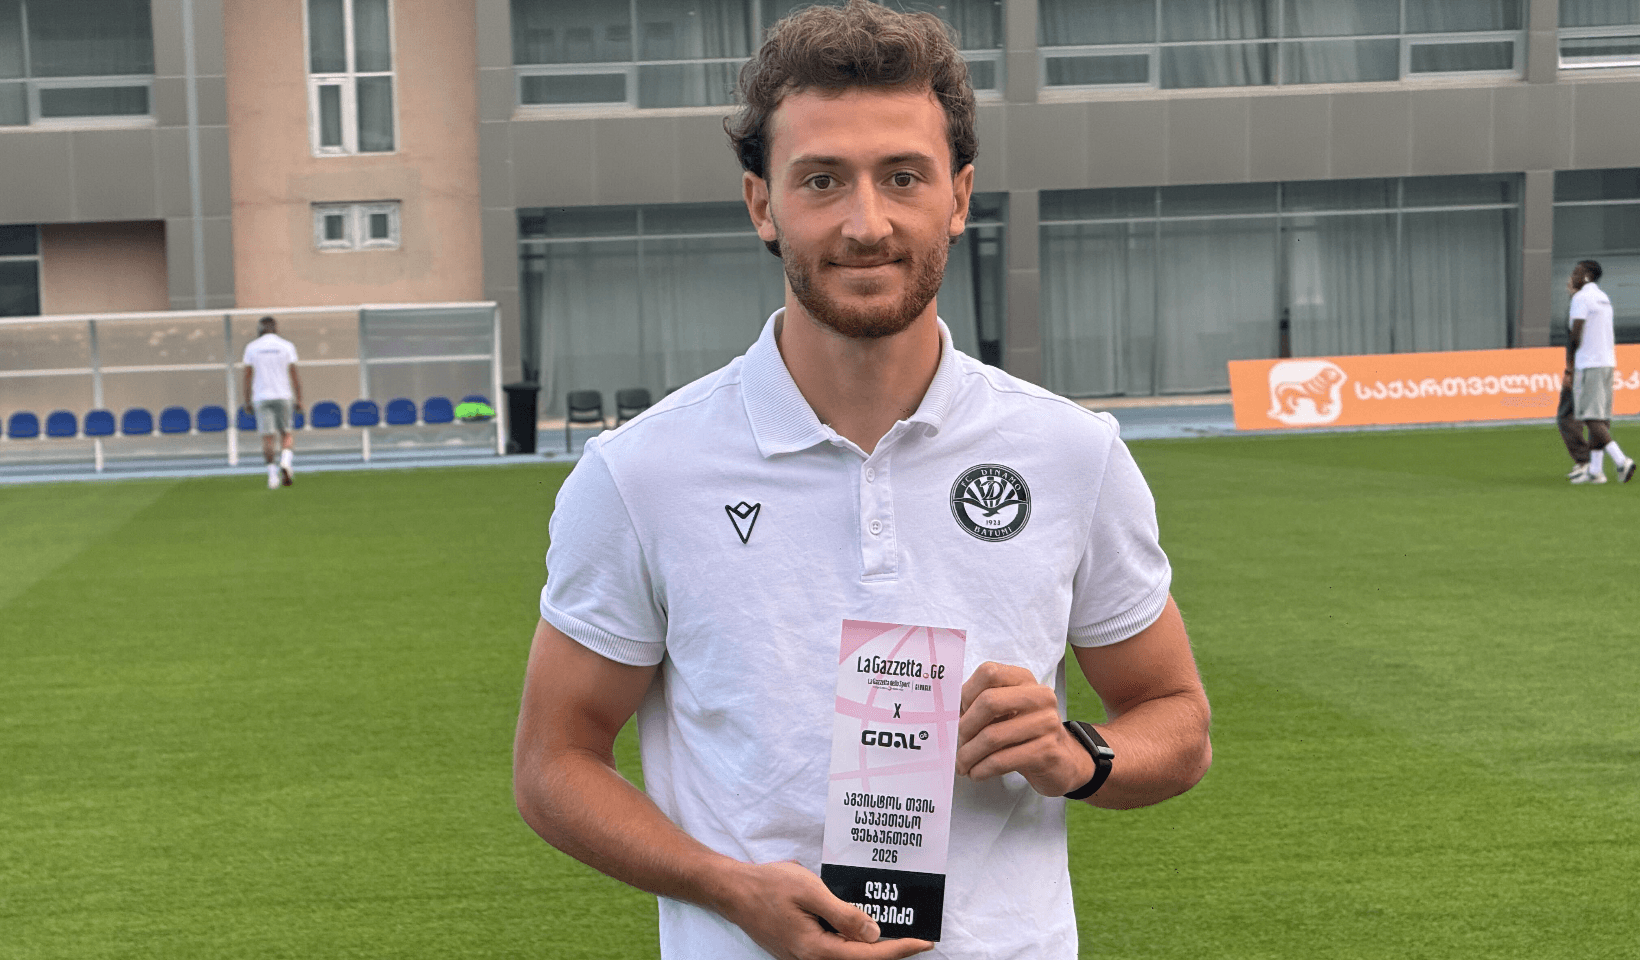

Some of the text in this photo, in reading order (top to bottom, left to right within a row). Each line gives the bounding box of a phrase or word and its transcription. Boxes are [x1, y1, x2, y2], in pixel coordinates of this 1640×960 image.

[961, 469, 1021, 491] FC DINAMO
[974, 525, 1012, 536] BATUMI
[861, 729, 921, 750] GOAL
[843, 791, 935, 814] აგვისტოს თვის
[855, 811, 921, 829] საუკეთესო
[851, 828, 922, 847] ფეხბურთელი
[872, 848, 898, 863] 2026
[864, 880, 899, 901] ლუკა
[848, 902, 914, 926] ლუკიძე
